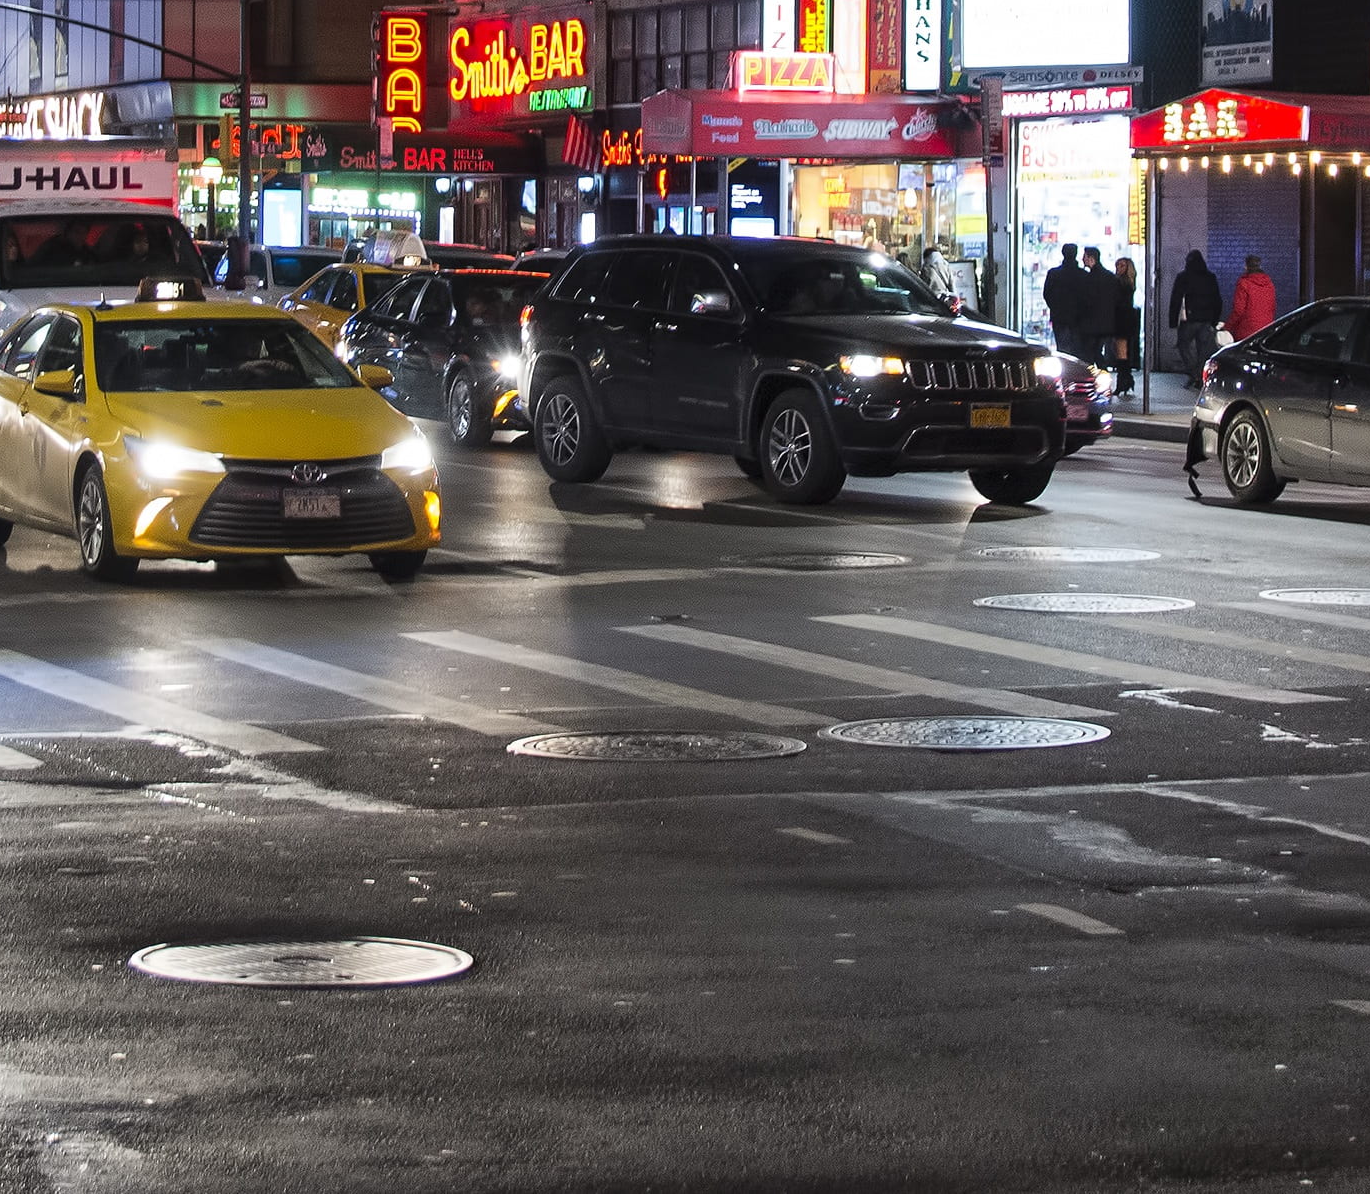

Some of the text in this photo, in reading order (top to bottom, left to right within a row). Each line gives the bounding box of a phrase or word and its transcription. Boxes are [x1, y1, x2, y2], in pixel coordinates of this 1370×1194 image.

[449, 18, 585, 101] Smith's BAR
[744, 56, 829, 87] PIZZA
[1099, 69, 1140, 79] DELSEY
[45, 91, 105, 140] SHACK
[752, 118, 819, 136] Nathan's
[1162, 99, 1241, 141] BAR
[824, 116, 898, 142] SUBWAY
[403, 146, 447, 172] BAR
[453, 148, 484, 160] HELL'S
[453, 159, 495, 173] KITCHEN
